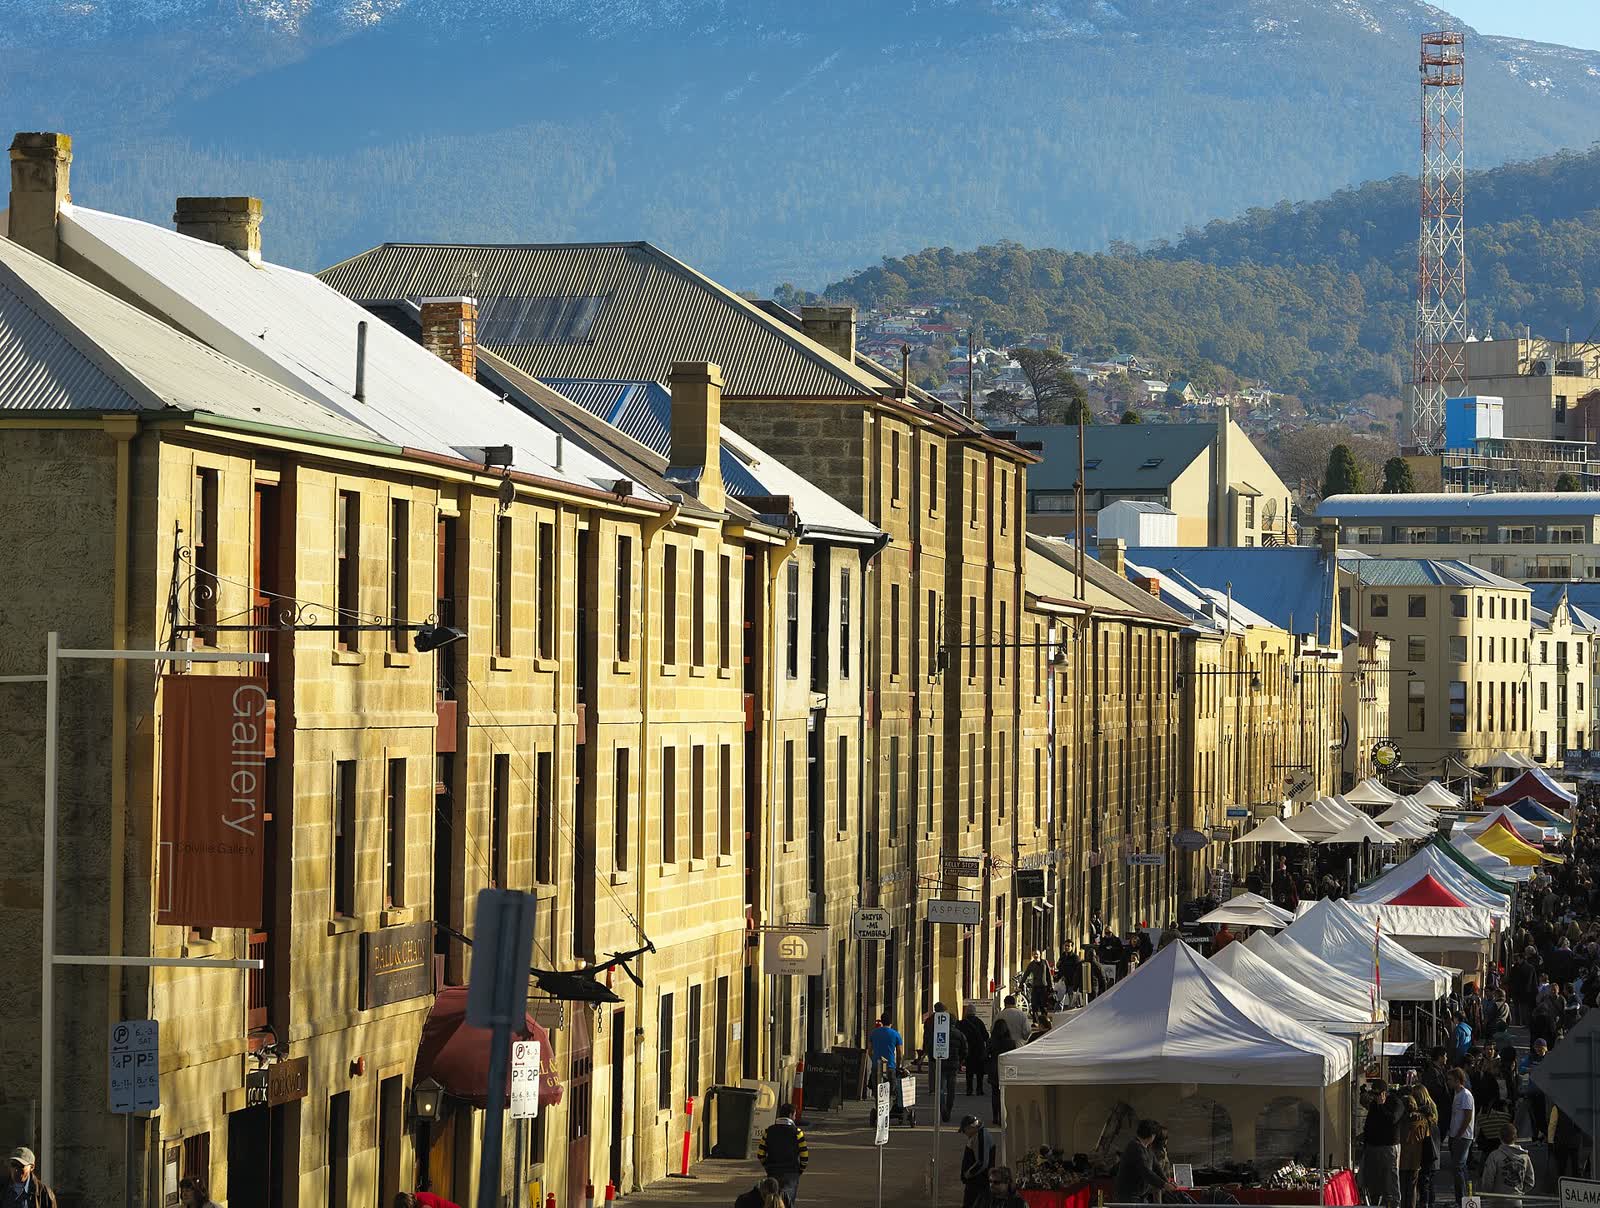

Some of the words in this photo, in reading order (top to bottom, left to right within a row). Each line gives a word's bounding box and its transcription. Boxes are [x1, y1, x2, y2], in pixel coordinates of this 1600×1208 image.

[221, 684, 267, 837] Gallery
[1287, 779, 1306, 799] grape
[217, 842, 255, 856] Gallery
[931, 905, 977, 915] ASPECT
[858, 930, 887, 938] TIMBERS
[781, 939, 804, 956] sh
[937, 1014, 947, 1025] 1P
[512, 1070, 519, 1082] P
[527, 1069, 539, 1081] 2P
